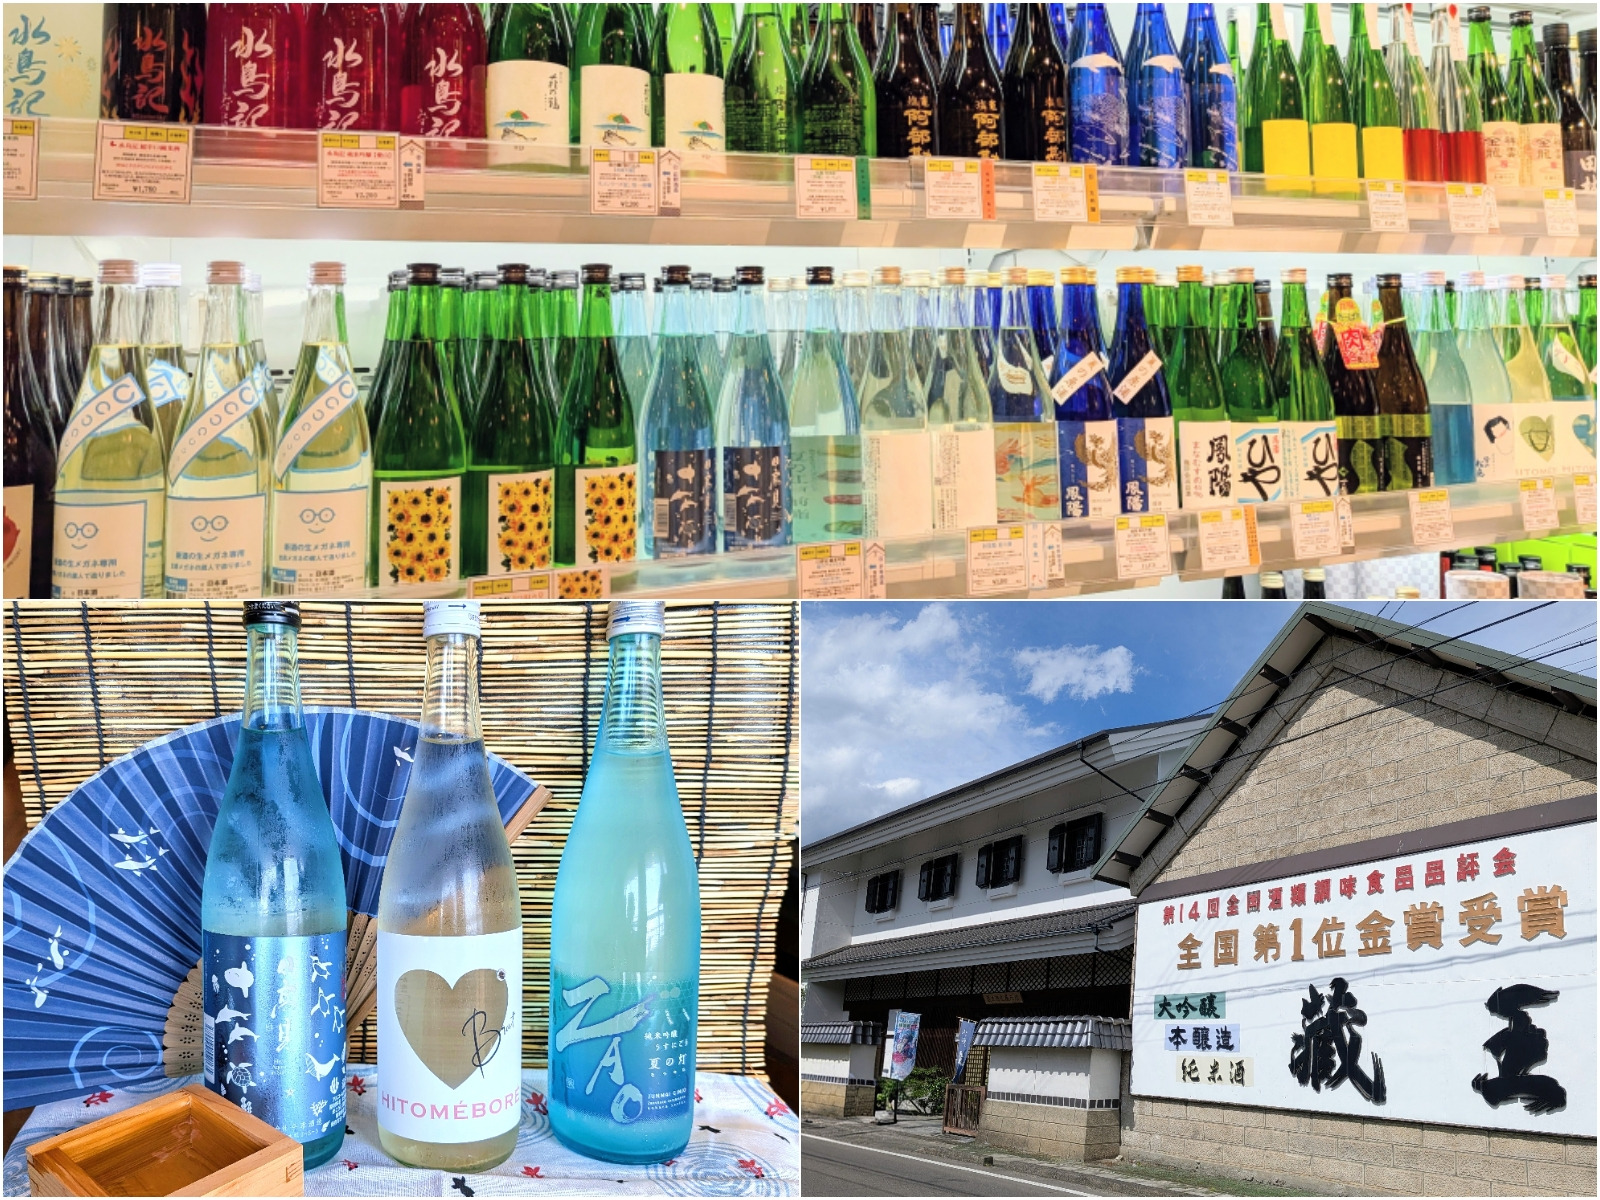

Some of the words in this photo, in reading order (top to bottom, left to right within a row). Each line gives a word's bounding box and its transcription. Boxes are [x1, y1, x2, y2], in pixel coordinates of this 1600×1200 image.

[6, 14, 51, 116] 水鳥記
[132, 25, 169, 114] 水鳥記
[229, 26, 273, 128] 水鳥記
[1341, 328, 1366, 352] 肉
[1207, 434, 1231, 497] 鳳陽
[1238, 434, 1281, 501] ひや
[555, 975, 655, 1124] ZAO
[643, 1029, 678, 1041] 純米吟醸
[648, 1053, 687, 1070] 夏の灯
[655, 1039, 689, 1051] うすにごり
[1181, 1058, 1245, 1087] 純米酒
